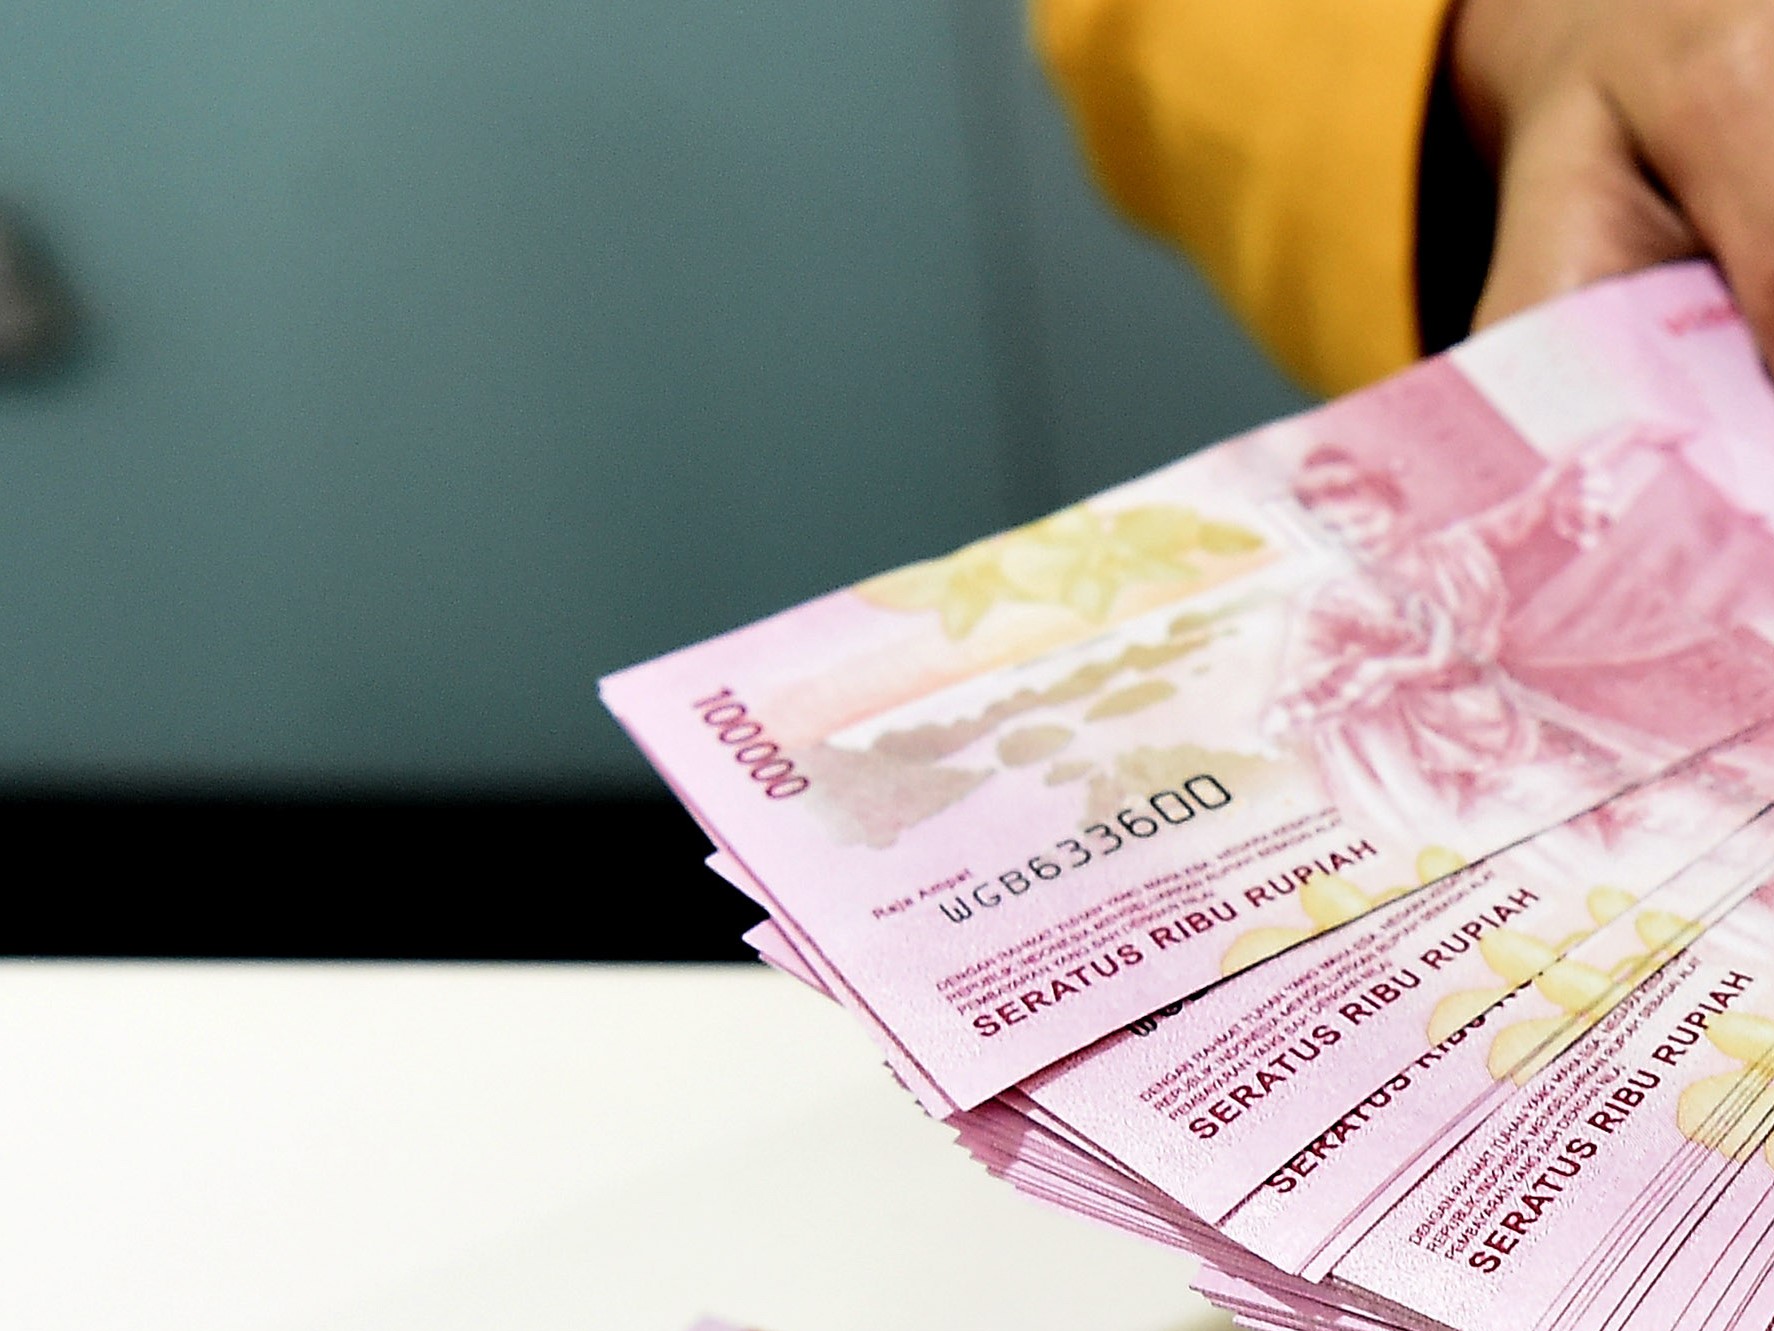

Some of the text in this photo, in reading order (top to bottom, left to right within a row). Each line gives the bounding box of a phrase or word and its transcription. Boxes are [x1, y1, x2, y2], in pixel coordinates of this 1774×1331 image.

[693, 687, 812, 800] 100000
[938, 773, 1233, 924] WGB633600
[972, 943, 1144, 1038] SERATUS
[1148, 901, 1238, 951] RIBU
[1243, 839, 1378, 909] RUPIAH
[1188, 1024, 1342, 1140] SERATUS
[1337, 968, 1421, 1026] RIBU
[1419, 888, 1540, 971] RUPIAH
[1468, 1137, 1598, 1274] SERATUS
[1585, 1069, 1661, 1135] RIBU
[1651, 970, 1754, 1067] RUPIAH
